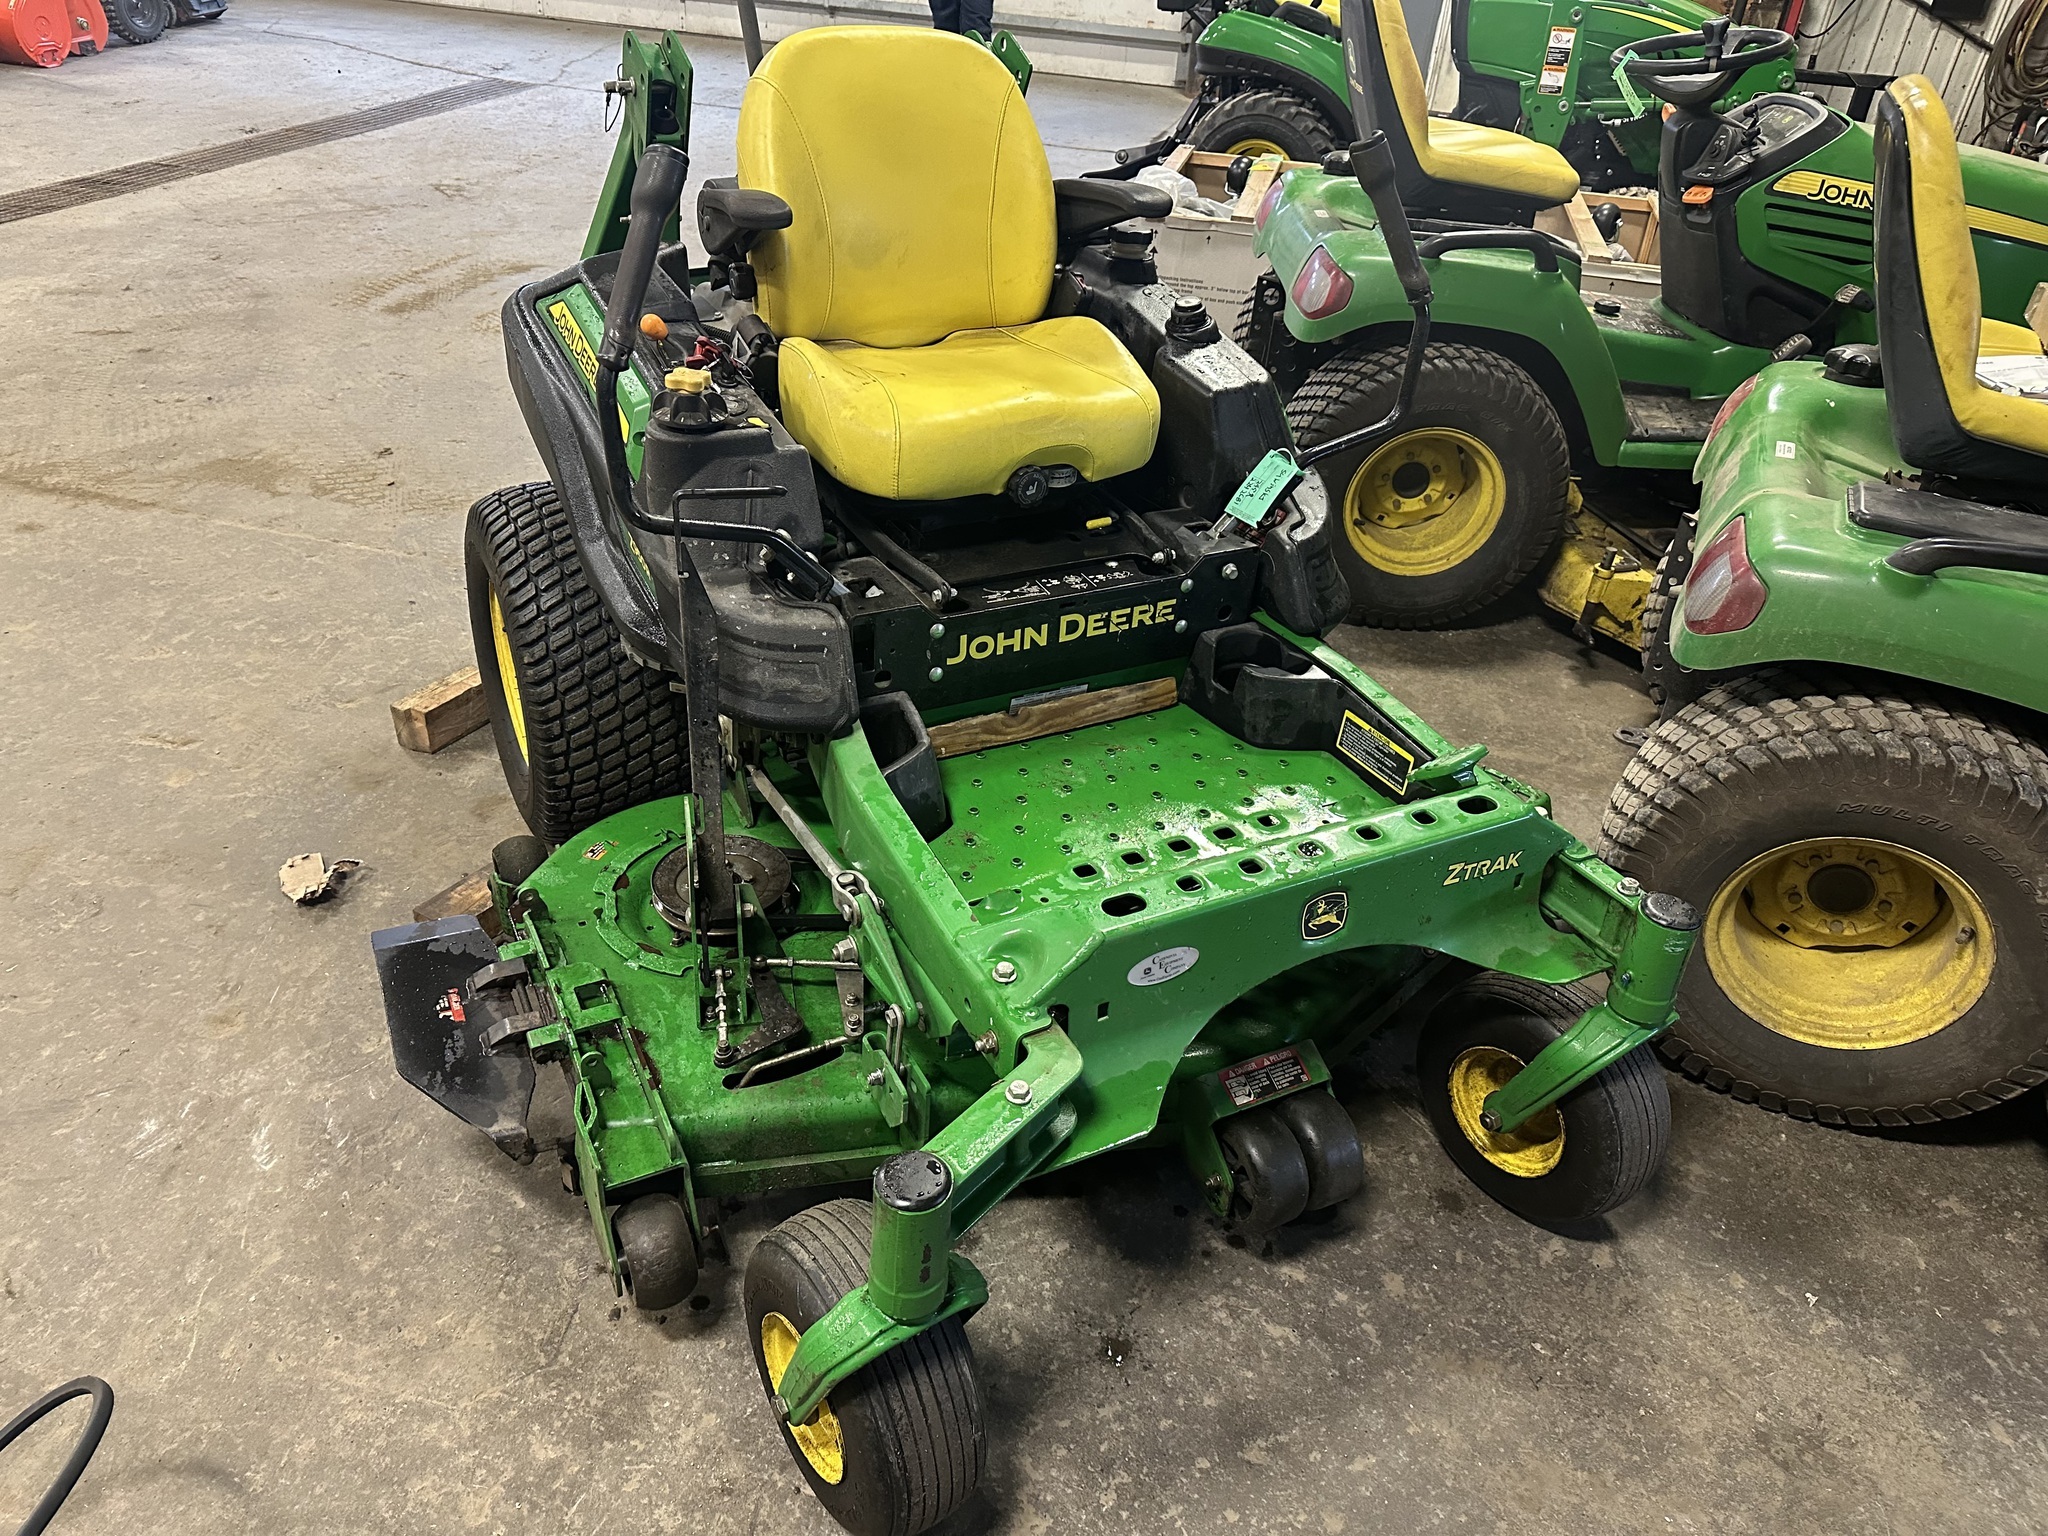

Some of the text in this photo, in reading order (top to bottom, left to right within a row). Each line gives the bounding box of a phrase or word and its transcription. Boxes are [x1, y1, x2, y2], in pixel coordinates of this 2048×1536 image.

[1806, 179, 1873, 210] JOHN
[947, 599, 1177, 665] JOHN DEERE
[1836, 802, 2041, 897] MULTI TRAC
[1443, 850, 1524, 886] ZTRAK
[1235, 1050, 1292, 1075] DANGER PELIGRO
